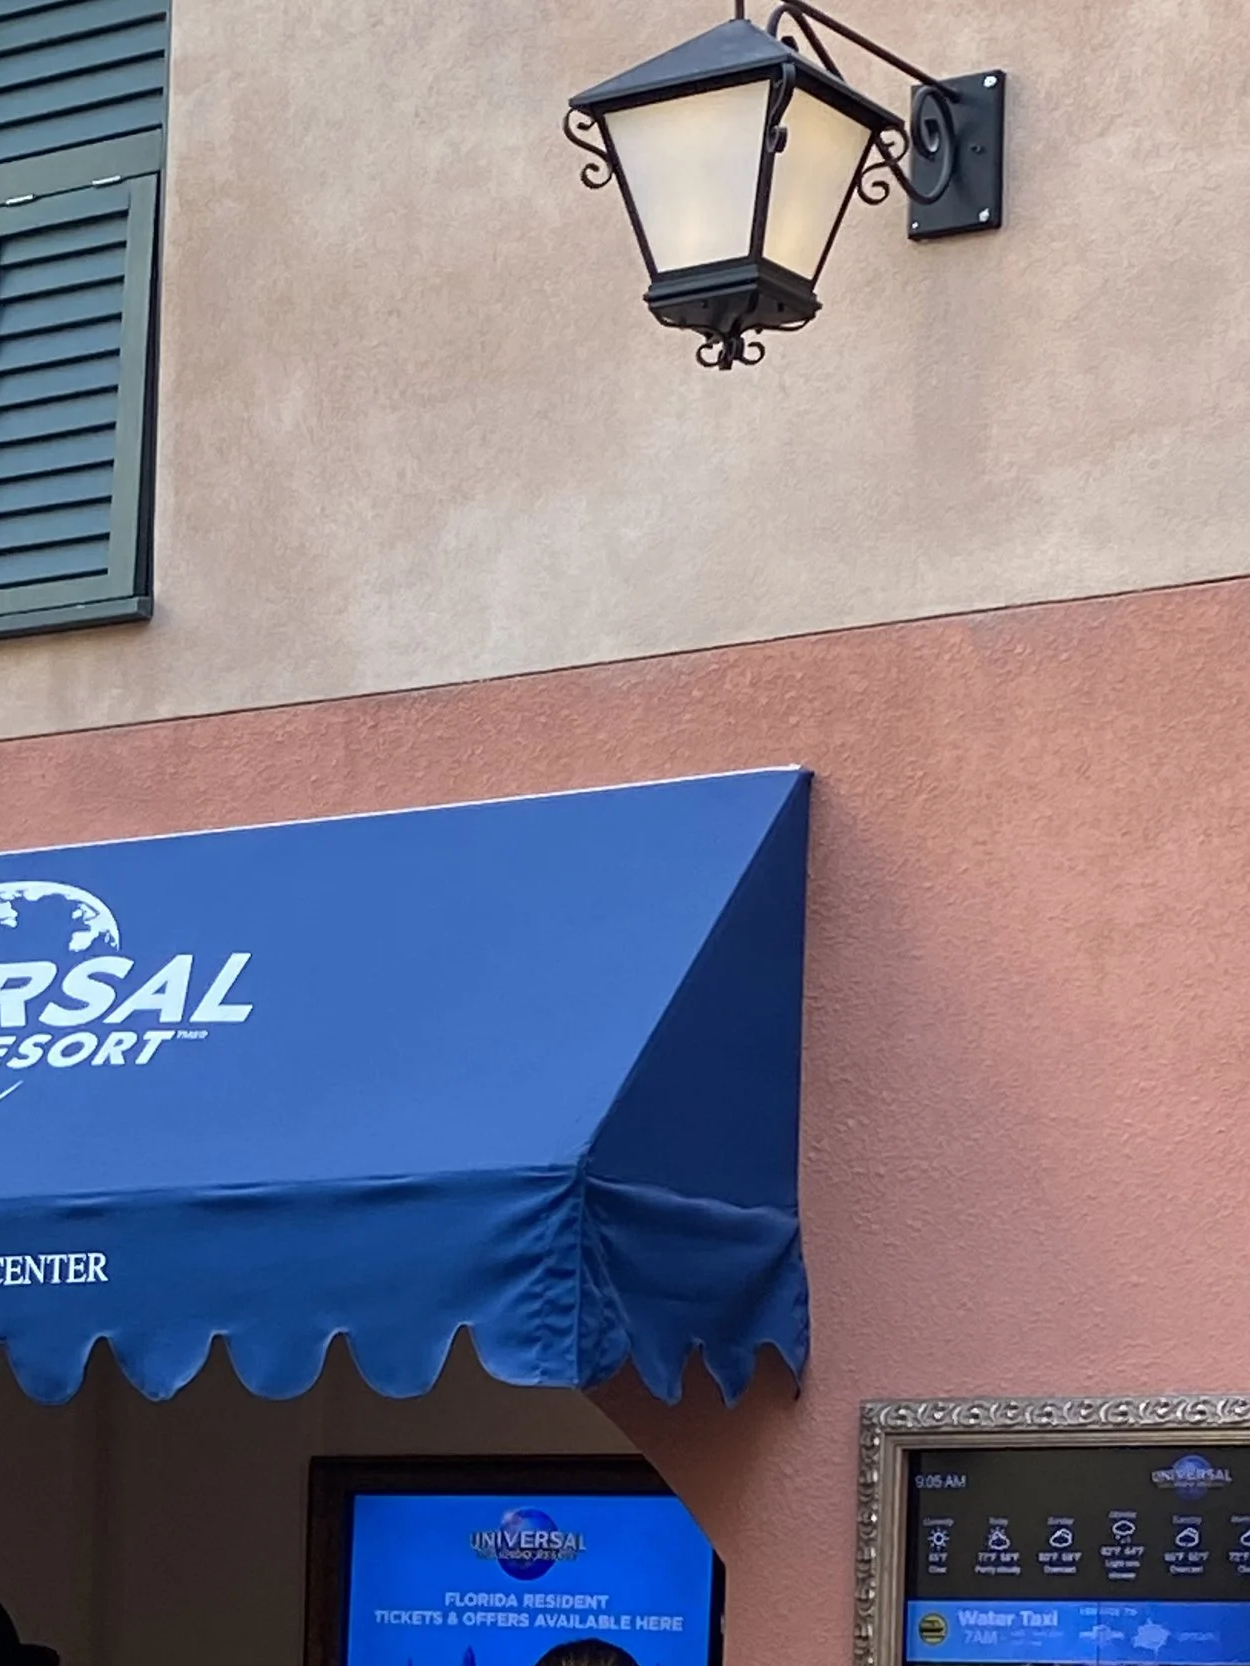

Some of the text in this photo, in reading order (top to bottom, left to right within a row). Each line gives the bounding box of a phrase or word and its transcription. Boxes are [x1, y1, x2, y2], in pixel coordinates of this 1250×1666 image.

[944, 1474, 967, 1489] AM
[1151, 1468, 1233, 1483] UNIVERSAL
[470, 1530, 587, 1552] UNIVERSAL
[444, 1591, 610, 1609] FLORIDA RESIDENT
[374, 1609, 443, 1626] TICKETS
[462, 1611, 530, 1628] OFFERS
[534, 1613, 632, 1630] AVAILABLE
[635, 1615, 684, 1632] HERE
[957, 1609, 1058, 1627] Water Taxi
[963, 1629, 998, 1645] 7AM
